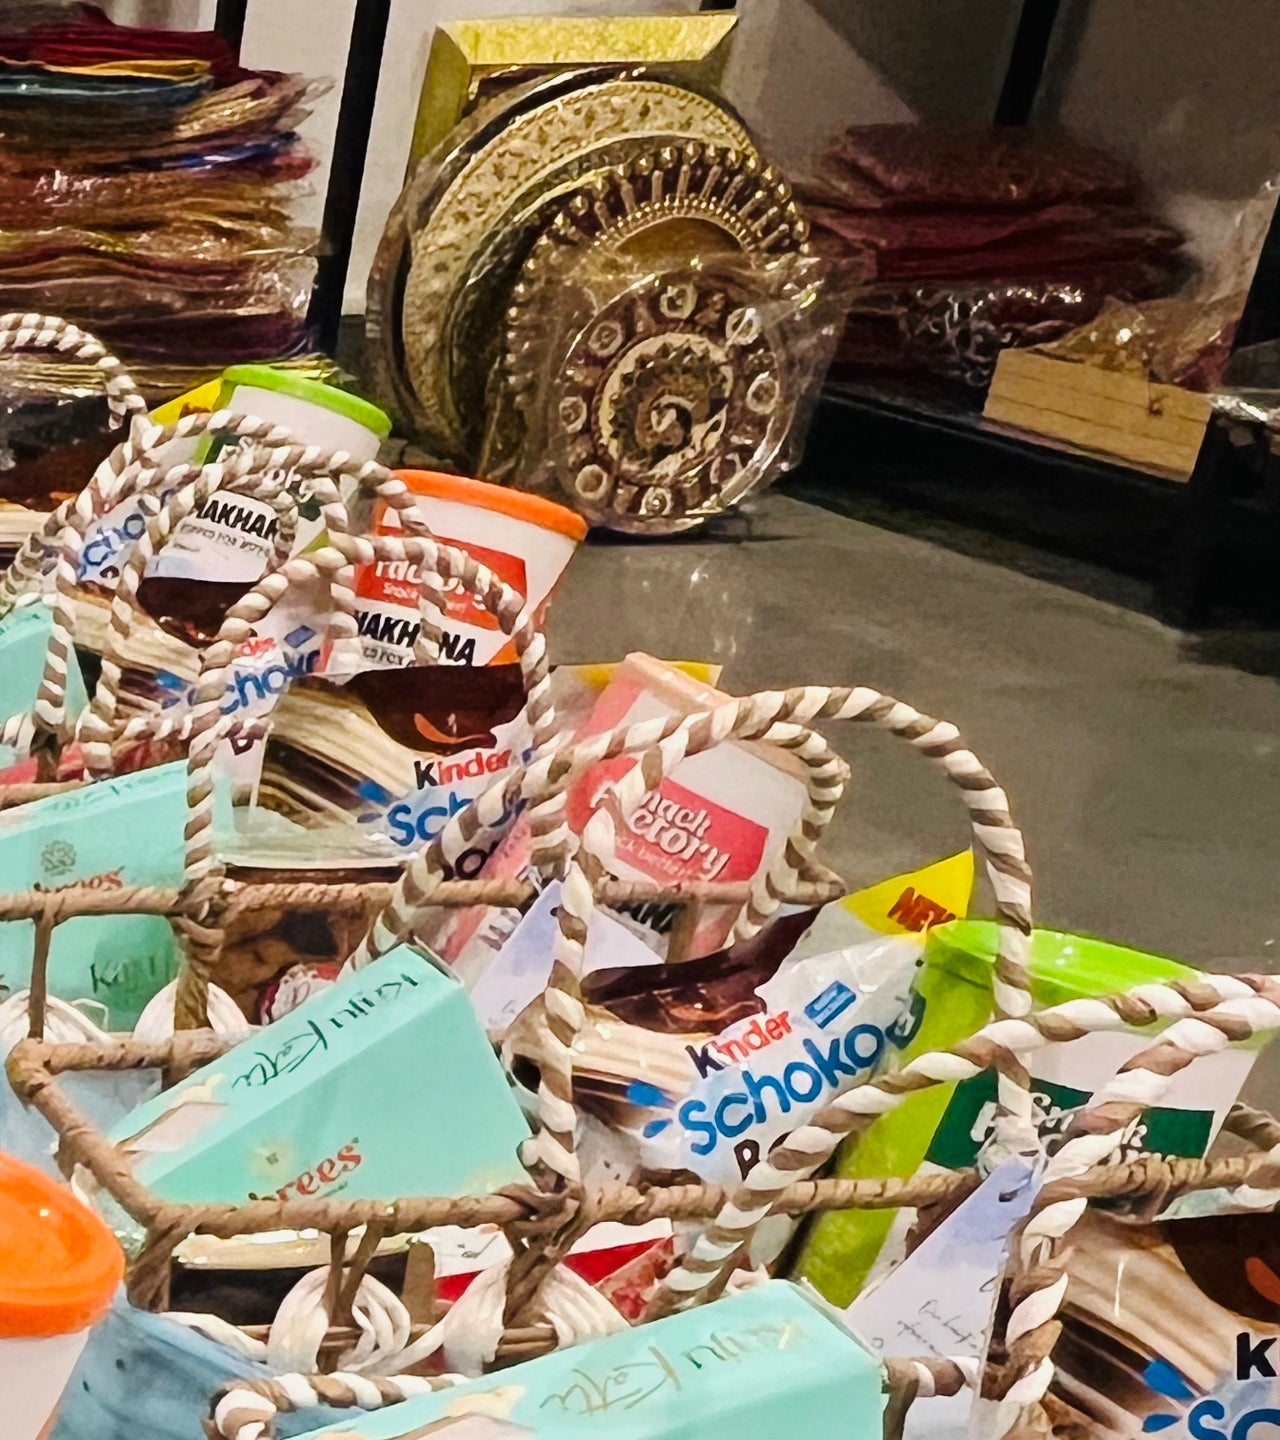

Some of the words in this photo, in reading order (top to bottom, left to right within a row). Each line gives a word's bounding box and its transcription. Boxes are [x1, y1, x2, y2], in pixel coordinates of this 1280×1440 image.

[196, 500, 279, 540] AKHAN
[354, 610, 476, 665] MAKHNA
[414, 749, 512, 790] Kinder
[639, 790, 712, 837] nack
